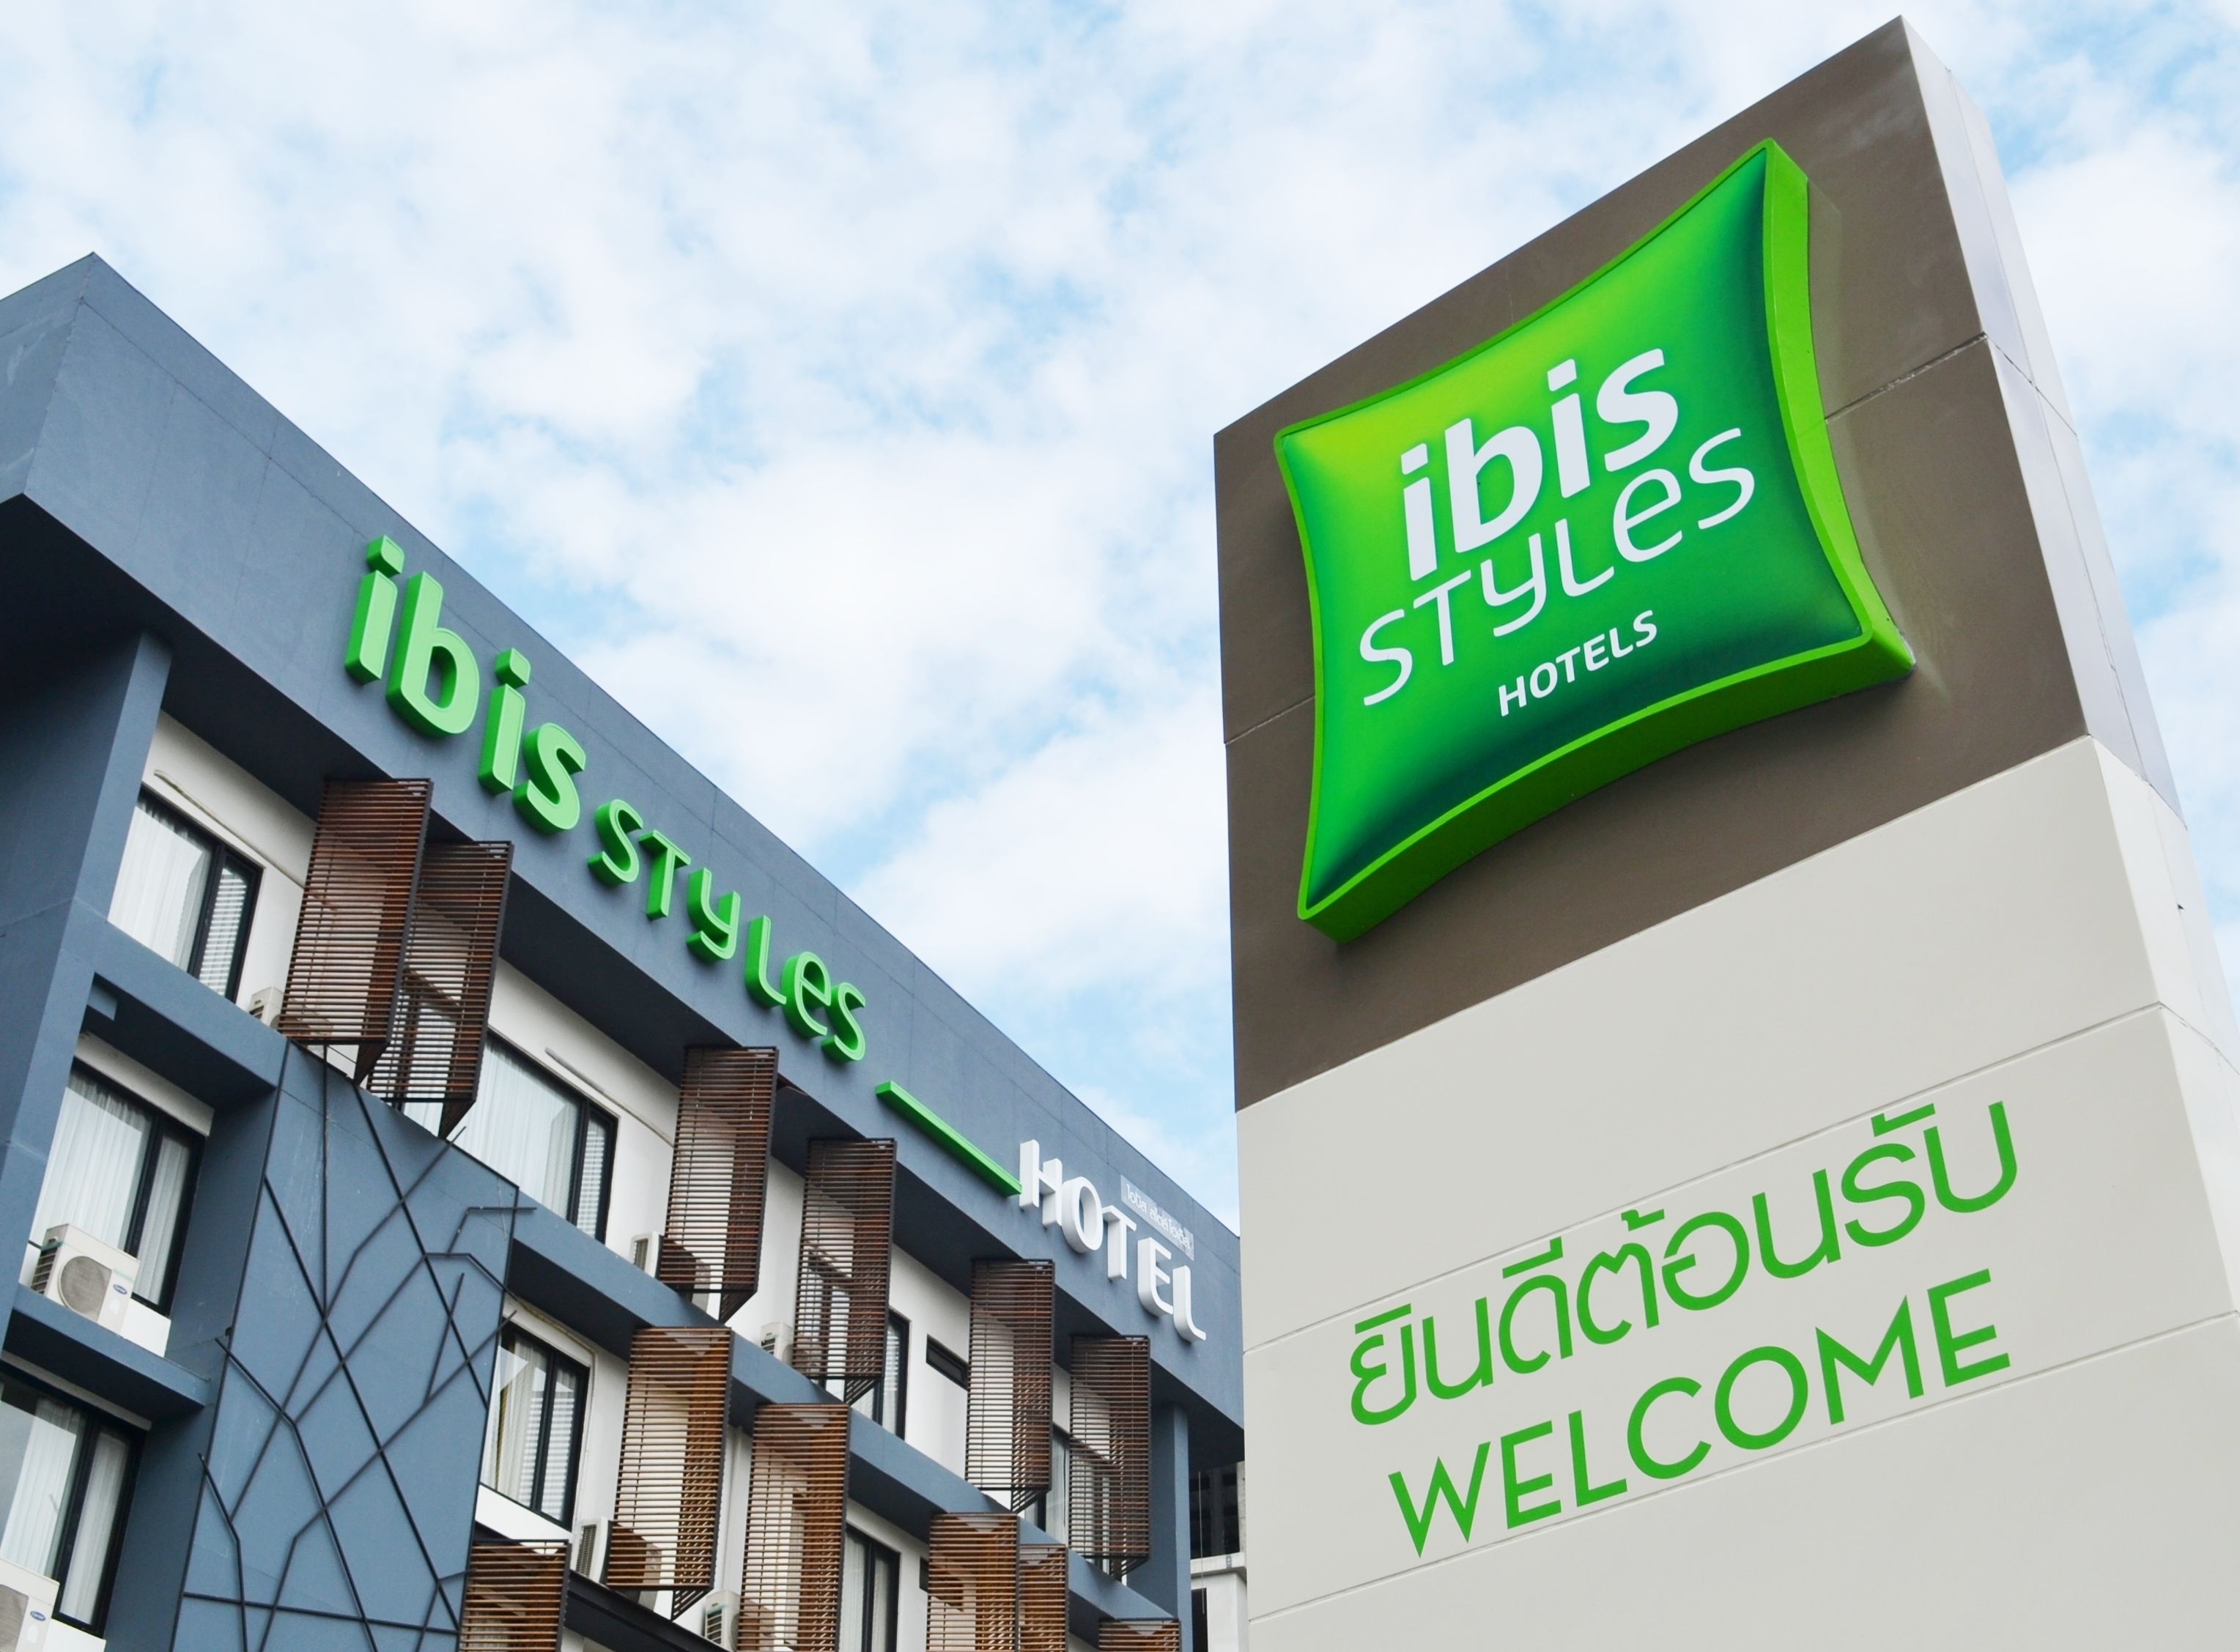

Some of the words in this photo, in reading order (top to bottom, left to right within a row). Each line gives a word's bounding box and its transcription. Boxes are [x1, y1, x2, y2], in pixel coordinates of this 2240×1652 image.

[1400, 348, 1679, 582] ibis
[345, 535, 586, 834] ibis
[1498, 610, 1658, 717] HOTELS
[1019, 1139, 1206, 1343] HOTEL
[1350, 1101, 2017, 1425] ยินดีต้อนรับ
[1388, 1268, 2011, 1559] WELCOME
